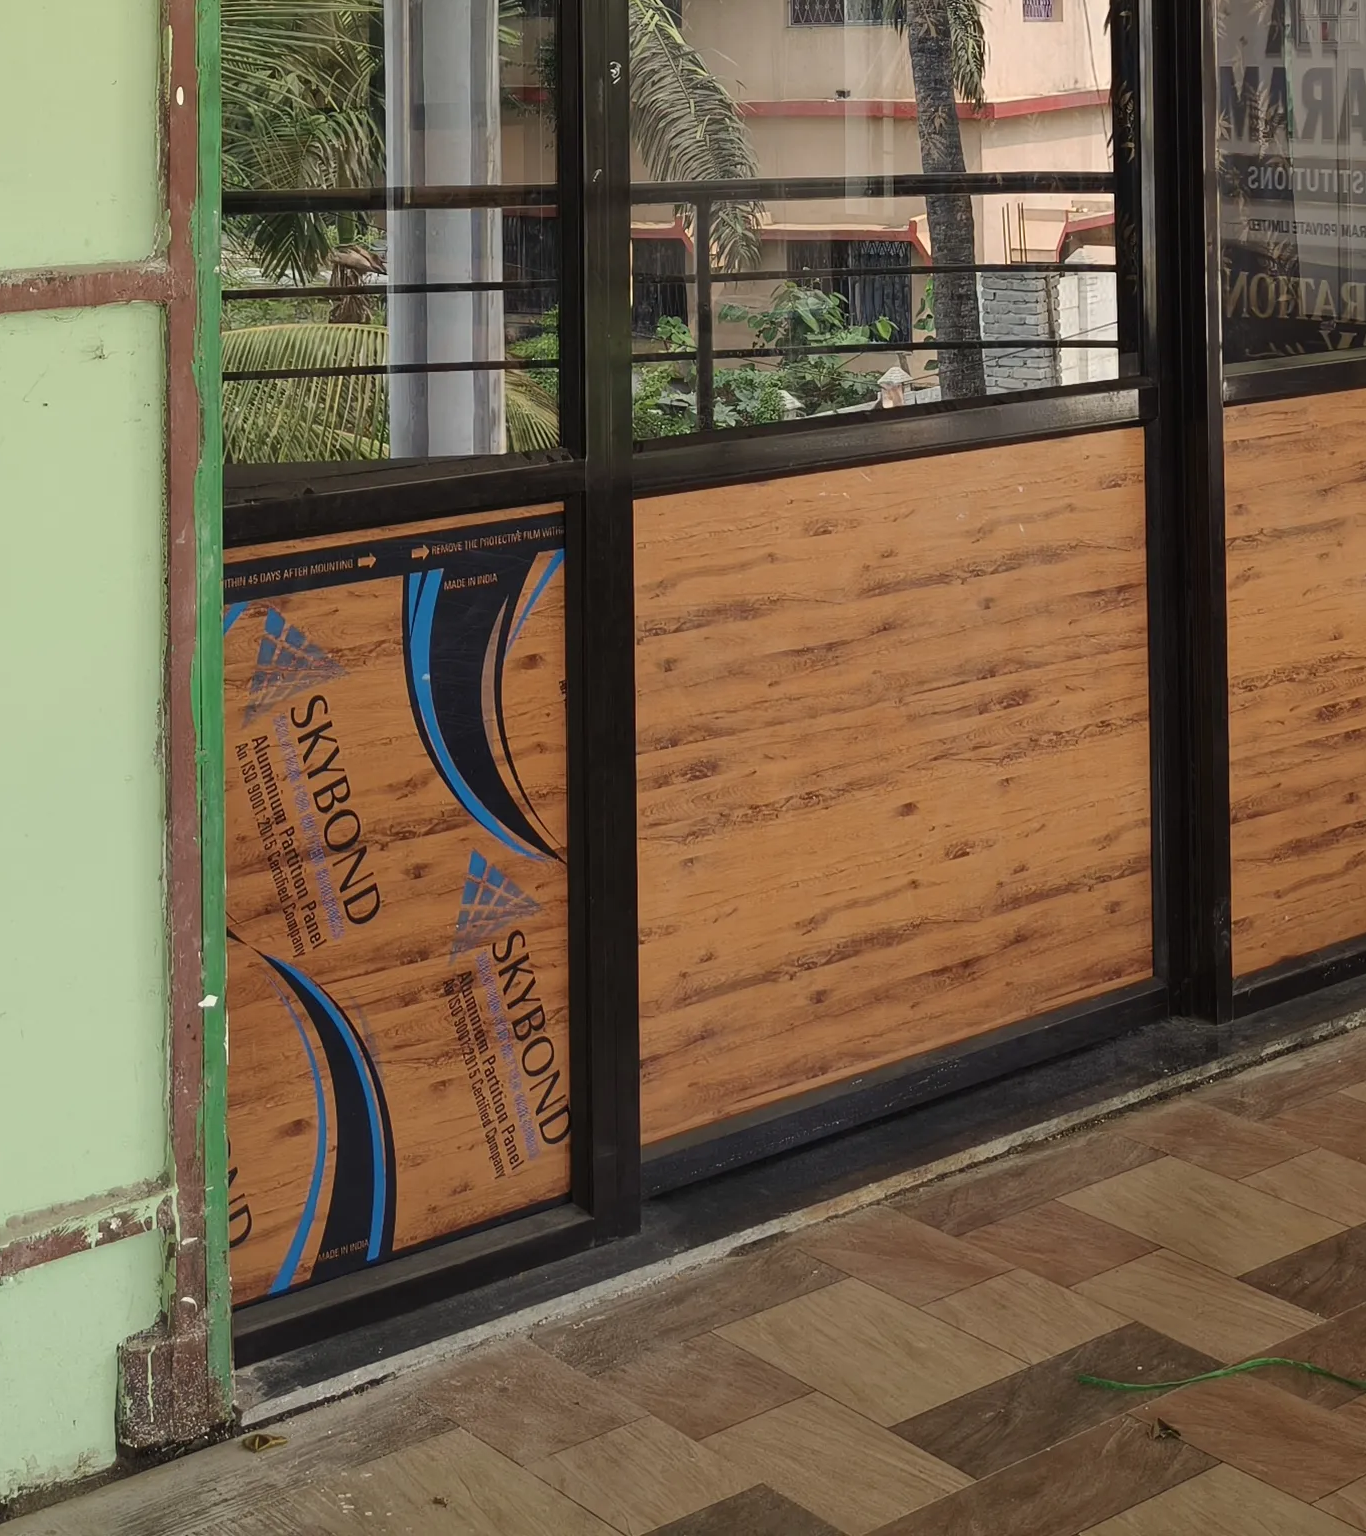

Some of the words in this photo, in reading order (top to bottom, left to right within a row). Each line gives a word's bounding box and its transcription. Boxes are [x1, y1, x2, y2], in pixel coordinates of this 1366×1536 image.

[444, 578, 467, 590] MADE
[477, 573, 498, 586] INDIA
[252, 735, 286, 825] Aluminium
[279, 826, 308, 897] Partition
[301, 900, 327, 950] Panel
[291, 694, 381, 925] SKYBOND
[283, 902, 305, 959] Company
[492, 930, 571, 1145] SKYBOND
